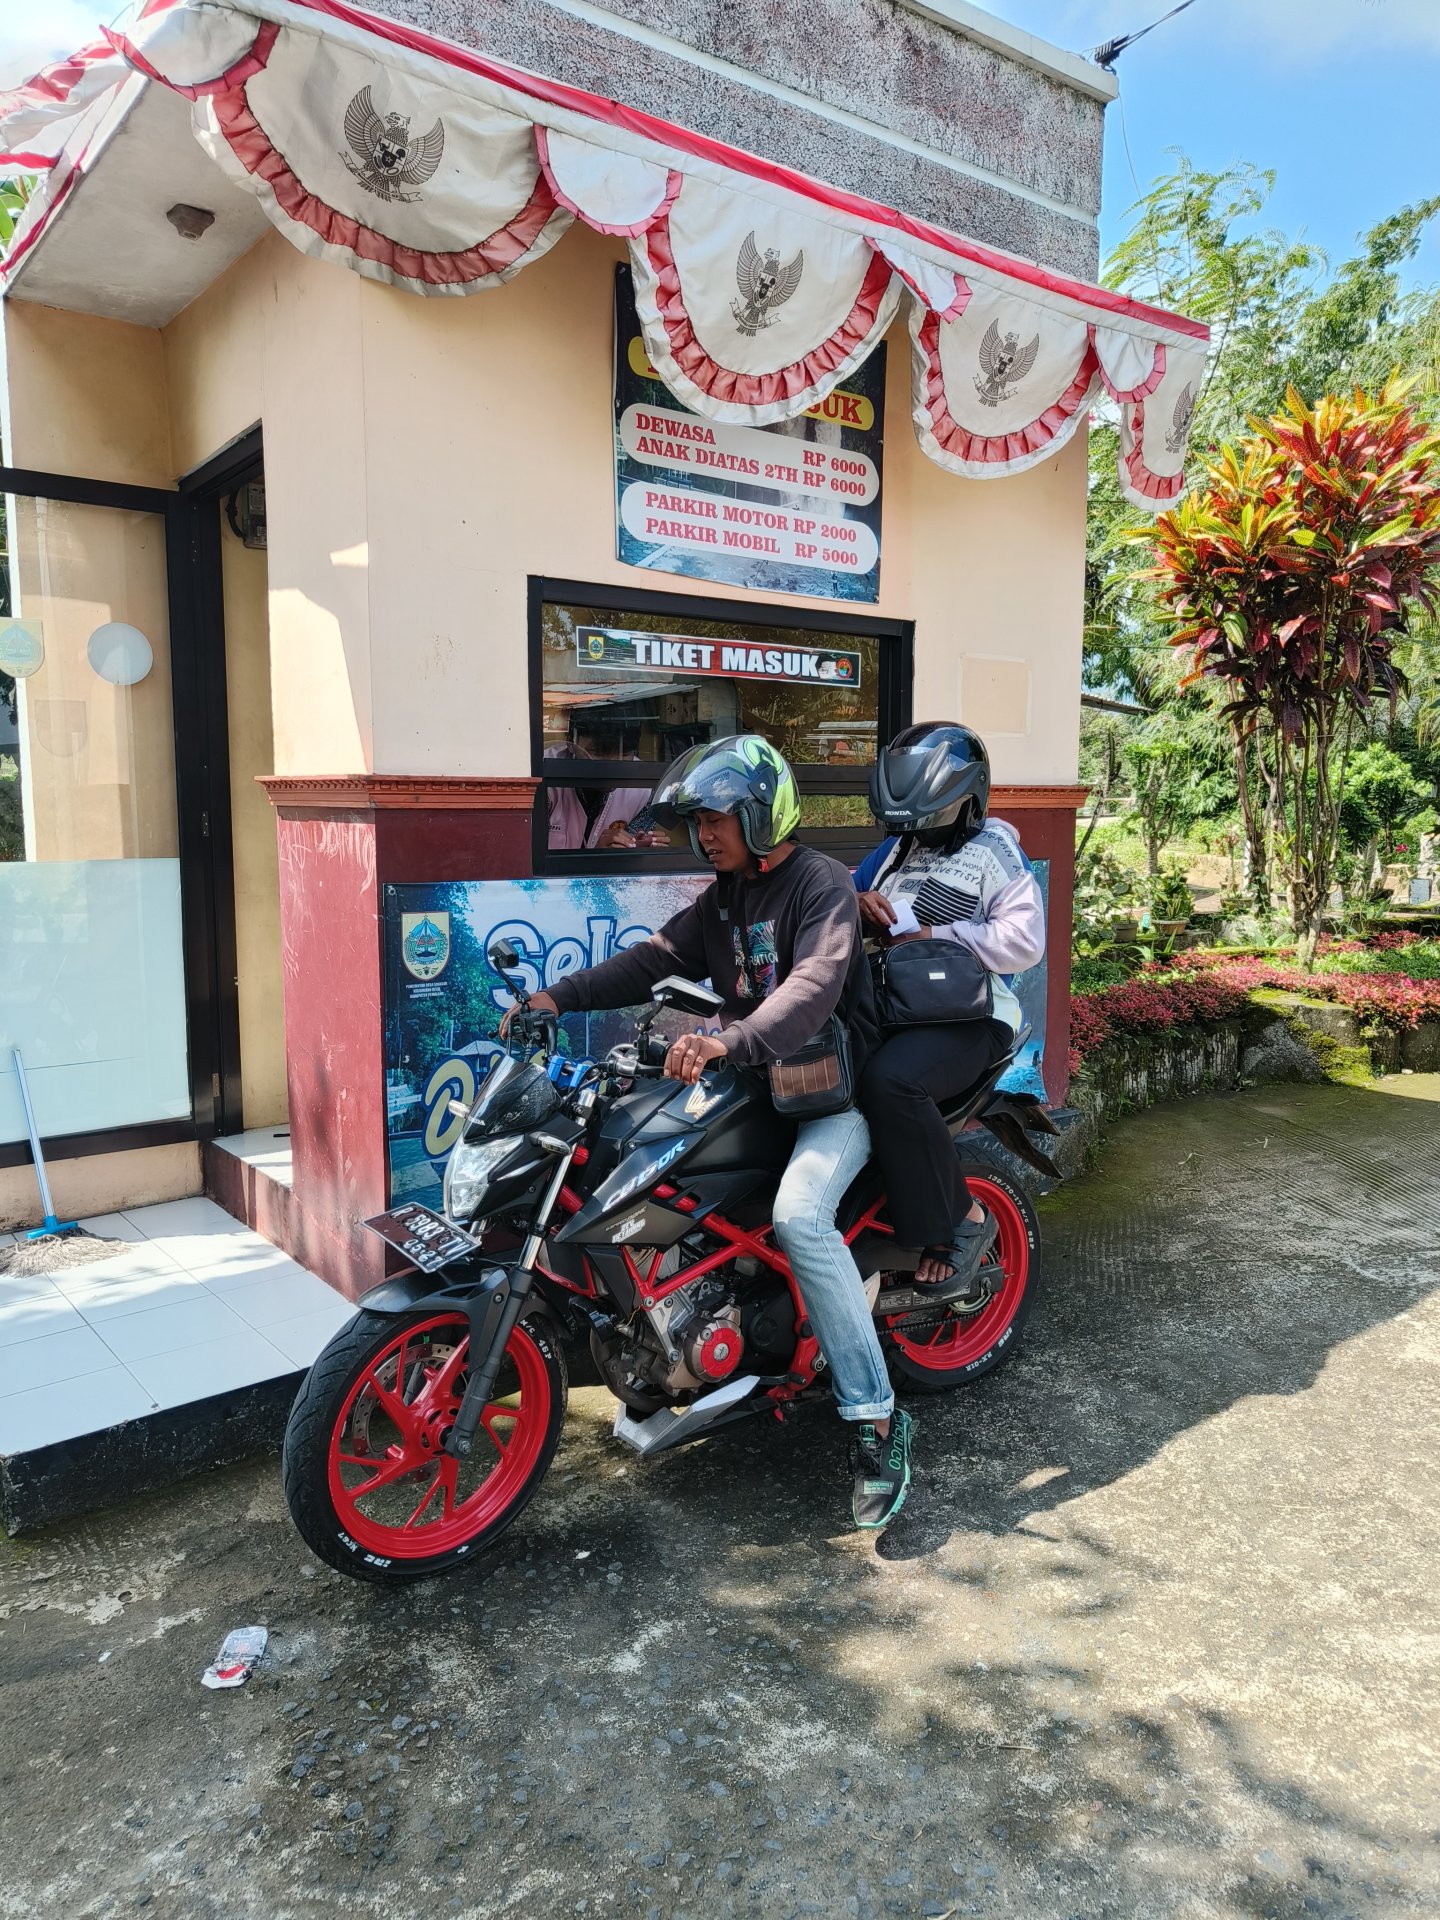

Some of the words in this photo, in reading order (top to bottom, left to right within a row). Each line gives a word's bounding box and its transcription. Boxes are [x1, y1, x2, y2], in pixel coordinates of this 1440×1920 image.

[636, 413, 716, 445] DEWASA
[803, 450, 826, 467] RP
[831, 458, 867, 477] 6000
[637, 437, 690, 461] ANAK
[695, 448, 760, 475] DIATAS
[765, 464, 798, 483] 2TH
[803, 470, 826, 487] RP
[831, 478, 866, 496] 6000
[645, 491, 718, 519] PARKIR
[723, 505, 788, 531] MOTOR
[794, 518, 816, 535] RP
[821, 524, 857, 543] 2000
[645, 517, 718, 544] PARKIR
[723, 530, 780, 554] MOBIL
[795, 542, 817, 558] RP
[822, 548, 858, 566] 5000
[630, 638, 715, 670] TIKET
[721, 646, 820, 678] MASUK
[404, 1213, 446, 1241] 5983
